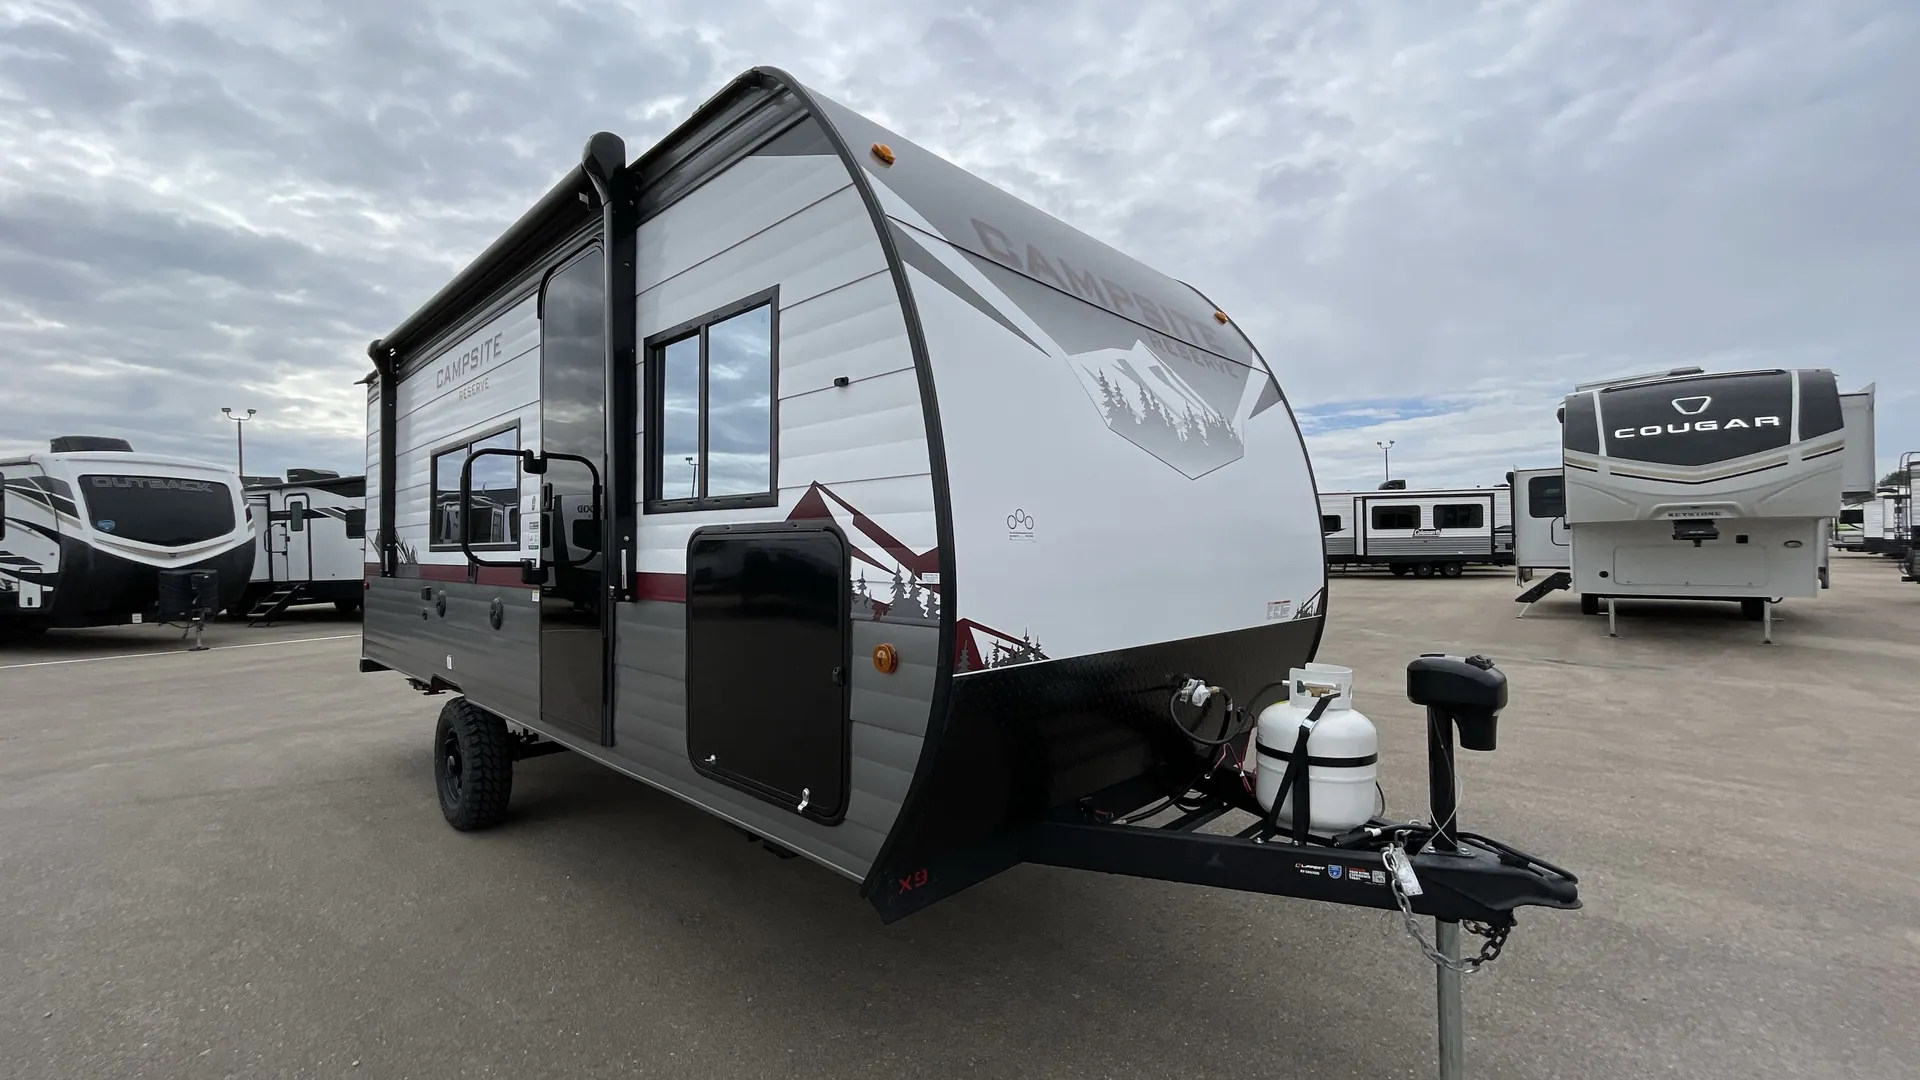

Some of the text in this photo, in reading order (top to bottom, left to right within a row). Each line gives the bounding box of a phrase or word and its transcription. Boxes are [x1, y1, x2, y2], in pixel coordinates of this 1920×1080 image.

[970, 217, 1227, 355] CAMPSITE
[436, 332, 502, 389] CAMPSITE
[1146, 331, 1238, 378] RESERVE
[458, 377, 490, 401] RESERVE
[1614, 415, 1780, 439] COUGAR
[91, 475, 213, 493] OUTBACK
